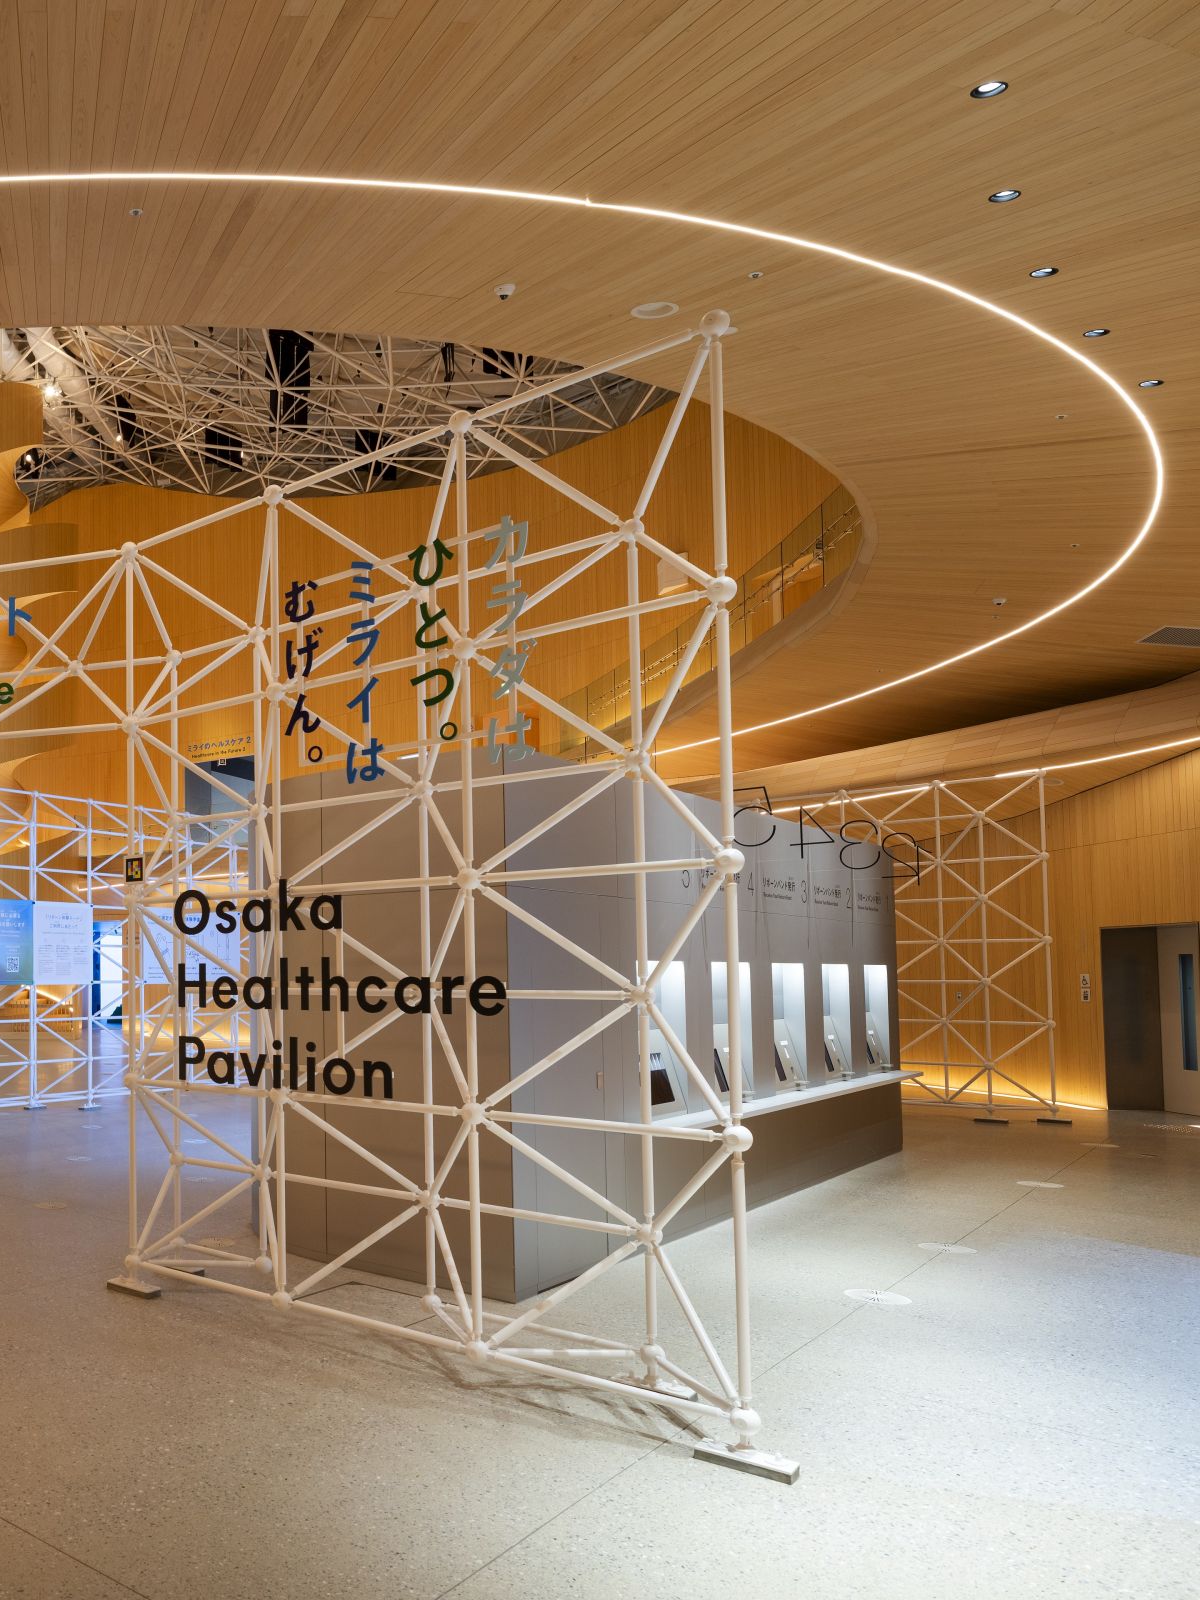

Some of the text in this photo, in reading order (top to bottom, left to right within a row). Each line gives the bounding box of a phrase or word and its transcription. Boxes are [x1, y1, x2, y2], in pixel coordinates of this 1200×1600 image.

[284, 580, 324, 763] むげん。
[347, 561, 386, 785] ミライは
[408, 538, 458, 741] ひとつ。
[484, 515, 538, 765] カラダは
[173, 878, 343, 935] Osaka
[178, 957, 507, 1017] Healthcare
[178, 1035, 394, 1099] Pavilion
